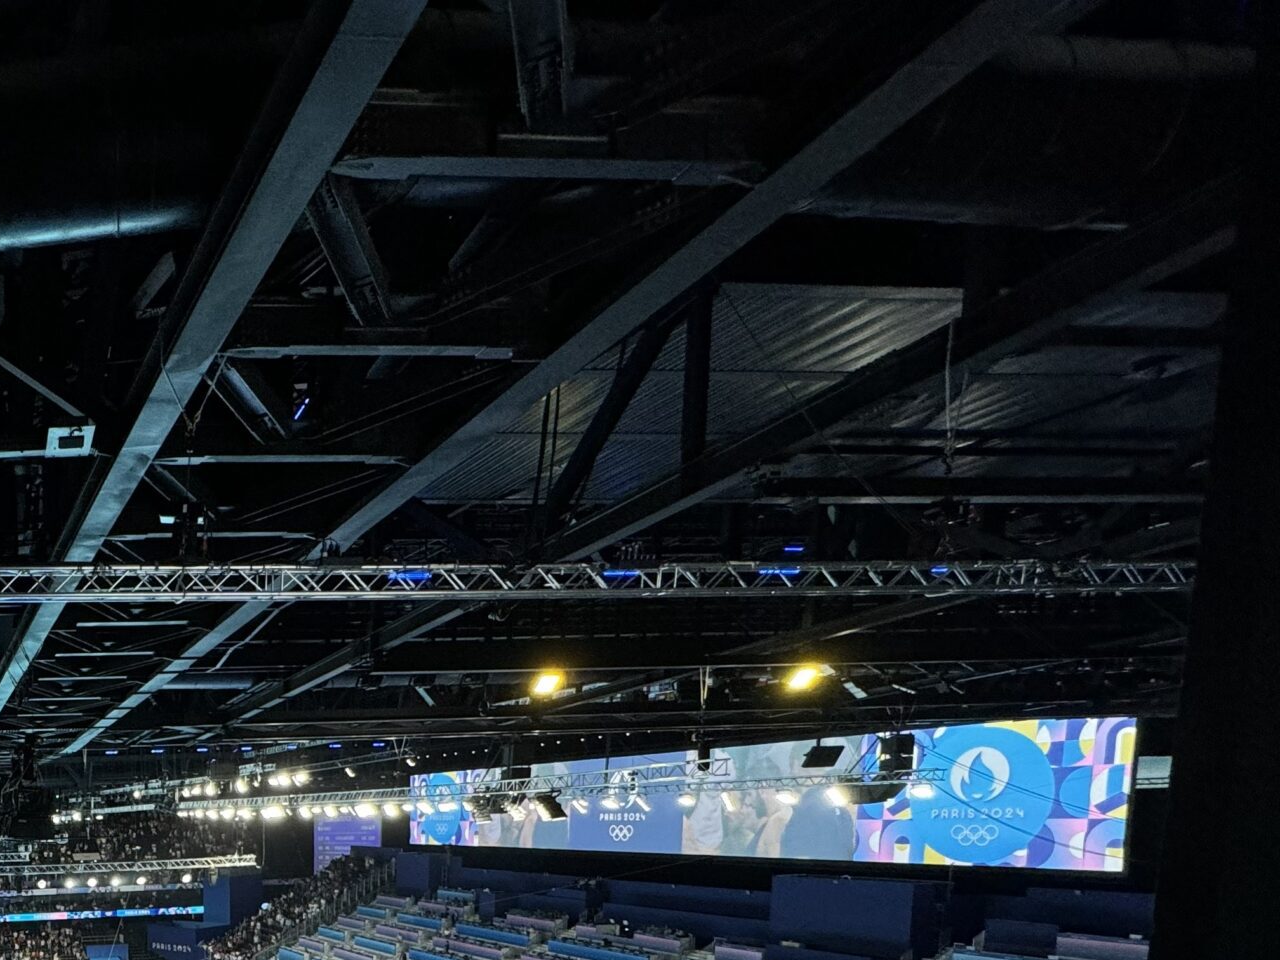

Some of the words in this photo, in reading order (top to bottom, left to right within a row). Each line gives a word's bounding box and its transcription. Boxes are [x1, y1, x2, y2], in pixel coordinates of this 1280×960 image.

[599, 813, 622, 821] PARIS
[623, 813, 646, 821] 2024
[931, 808, 975, 819] PARIS
[981, 807, 1025, 819] 2024
